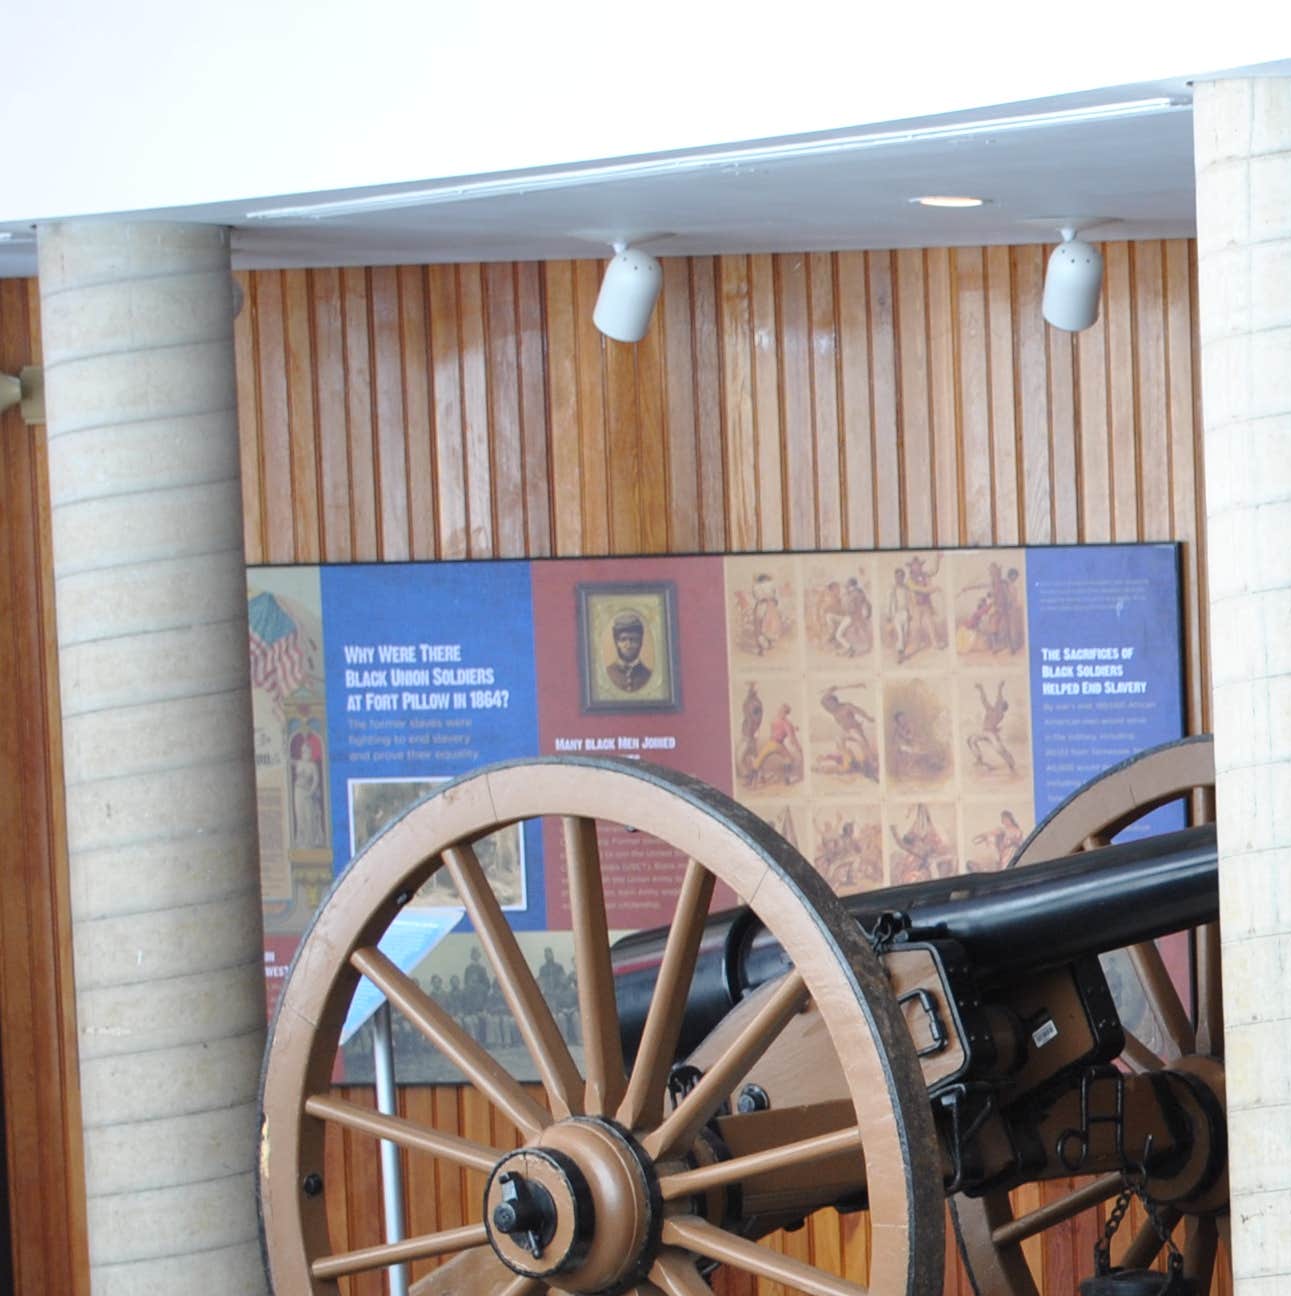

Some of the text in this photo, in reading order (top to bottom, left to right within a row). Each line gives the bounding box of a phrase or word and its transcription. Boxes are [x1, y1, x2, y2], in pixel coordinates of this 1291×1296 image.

[344, 643, 462, 664] WHY WERE THERE
[1042, 647, 1134, 661] THE SACRIFICES OF
[345, 667, 495, 688] BLACK UNION SOLDIERS
[1042, 664, 1124, 678] BLACK SOLDIERS
[1042, 680, 1147, 695] HELPED END SLAVERY
[347, 690, 510, 711] AT FORT PILLOW IN 1864?
[556, 736, 676, 751] MANY BLACK MEN JOINED
